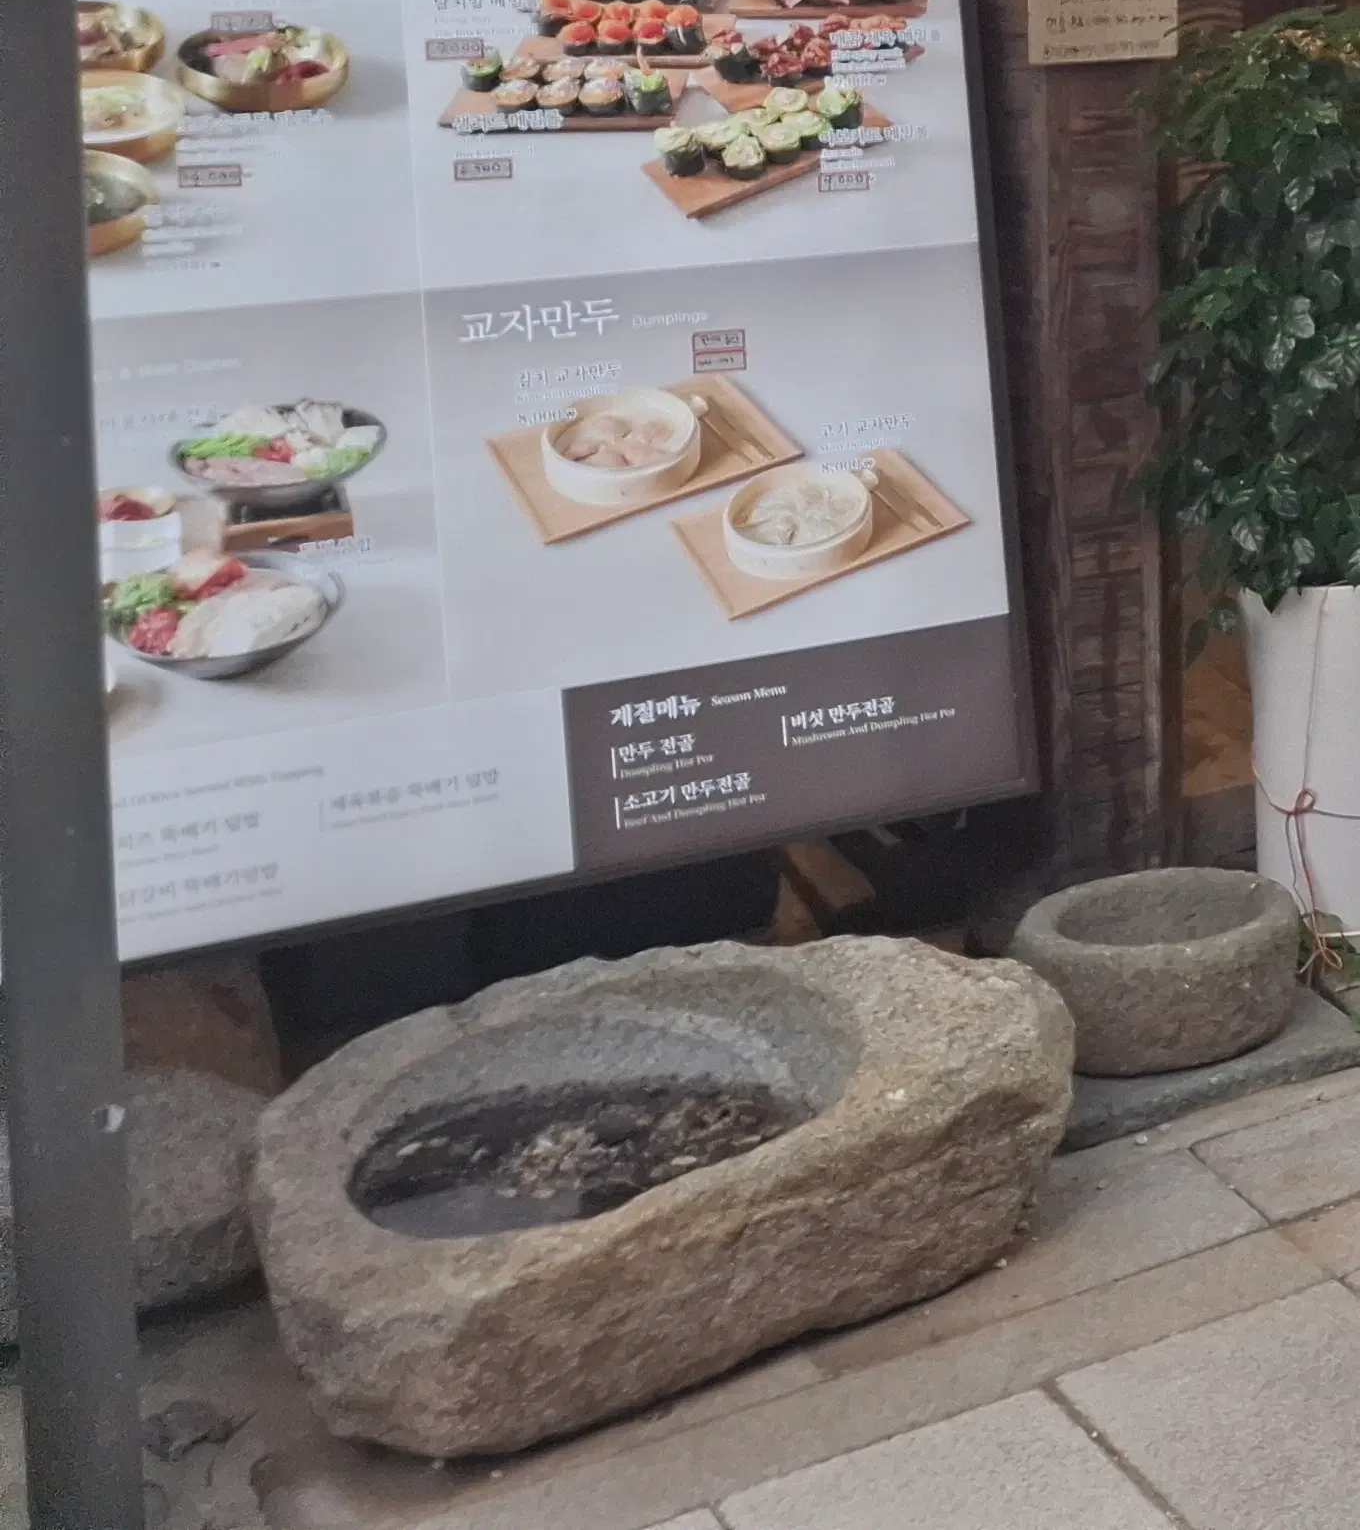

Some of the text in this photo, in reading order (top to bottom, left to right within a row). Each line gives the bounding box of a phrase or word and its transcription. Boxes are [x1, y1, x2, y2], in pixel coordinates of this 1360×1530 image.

[457, 298, 619, 343] 교자만두
[711, 686, 788, 707] Season Menu
[790, 708, 824, 730] 버섯
[618, 739, 655, 763] 만두
[623, 785, 675, 811] 소고기
